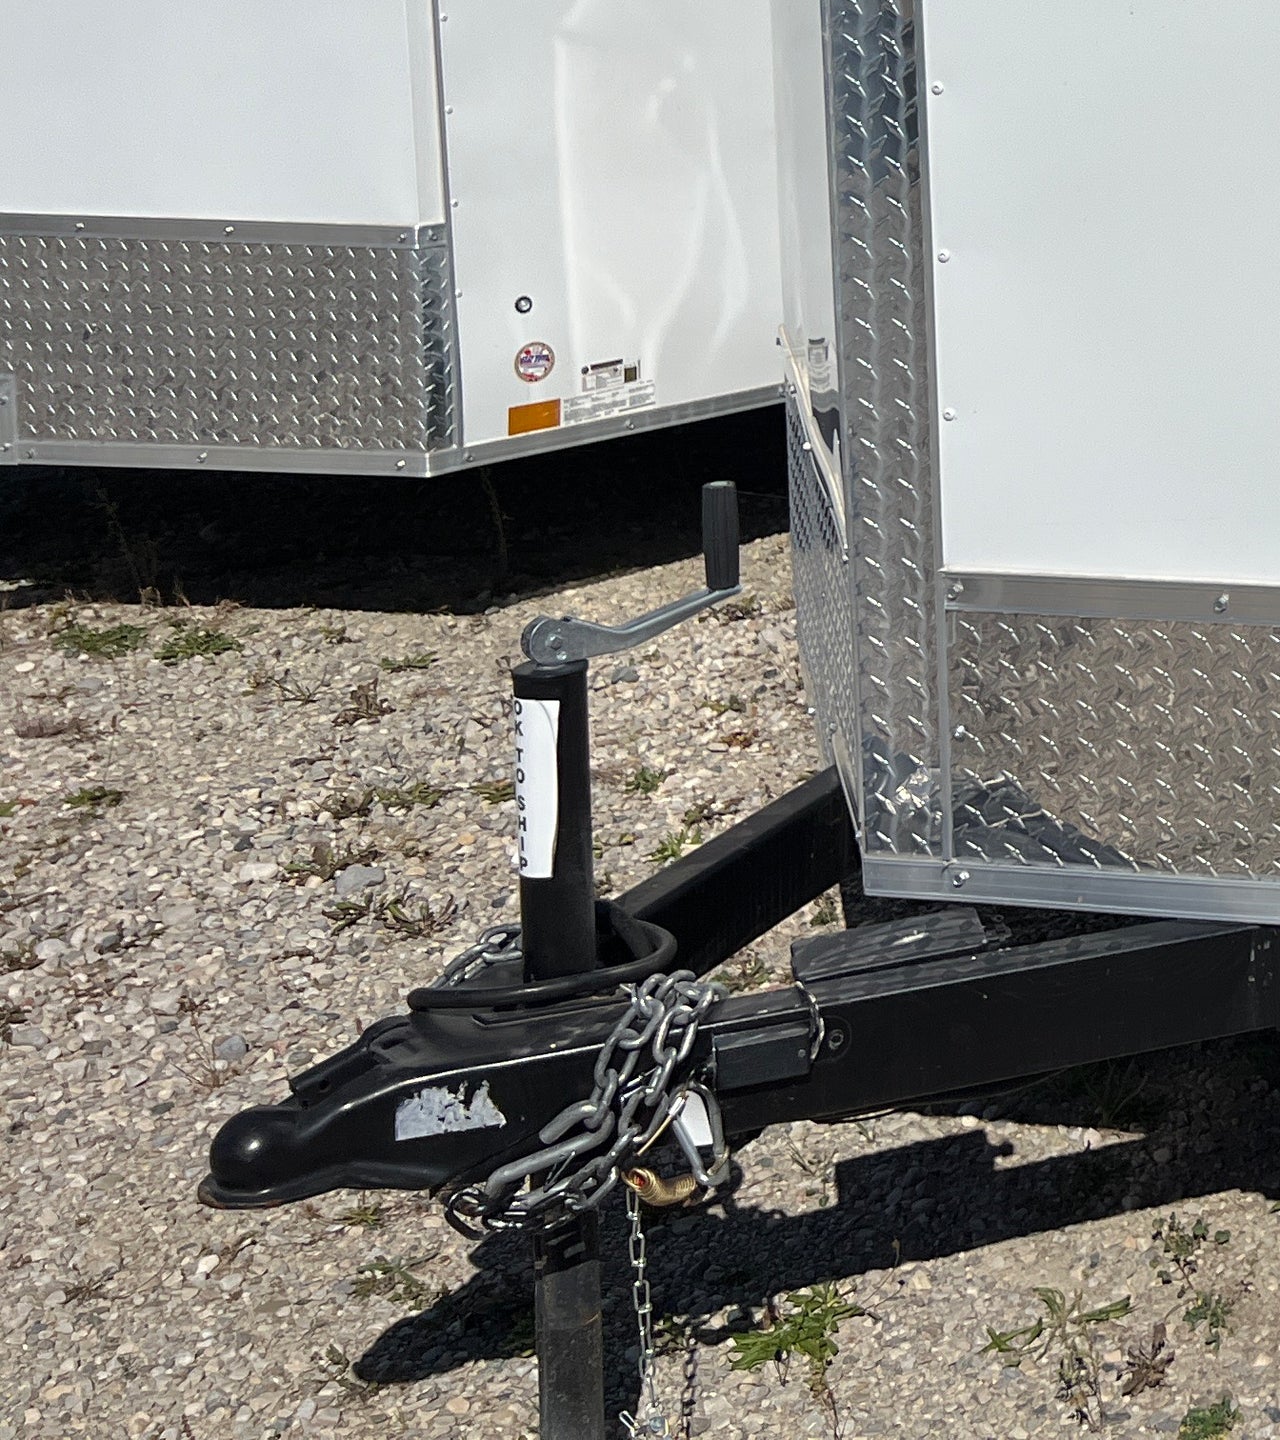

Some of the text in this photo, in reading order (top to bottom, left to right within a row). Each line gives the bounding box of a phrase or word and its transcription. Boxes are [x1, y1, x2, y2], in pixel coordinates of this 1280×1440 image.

[513, 700, 528, 871] OK TO SHIP
